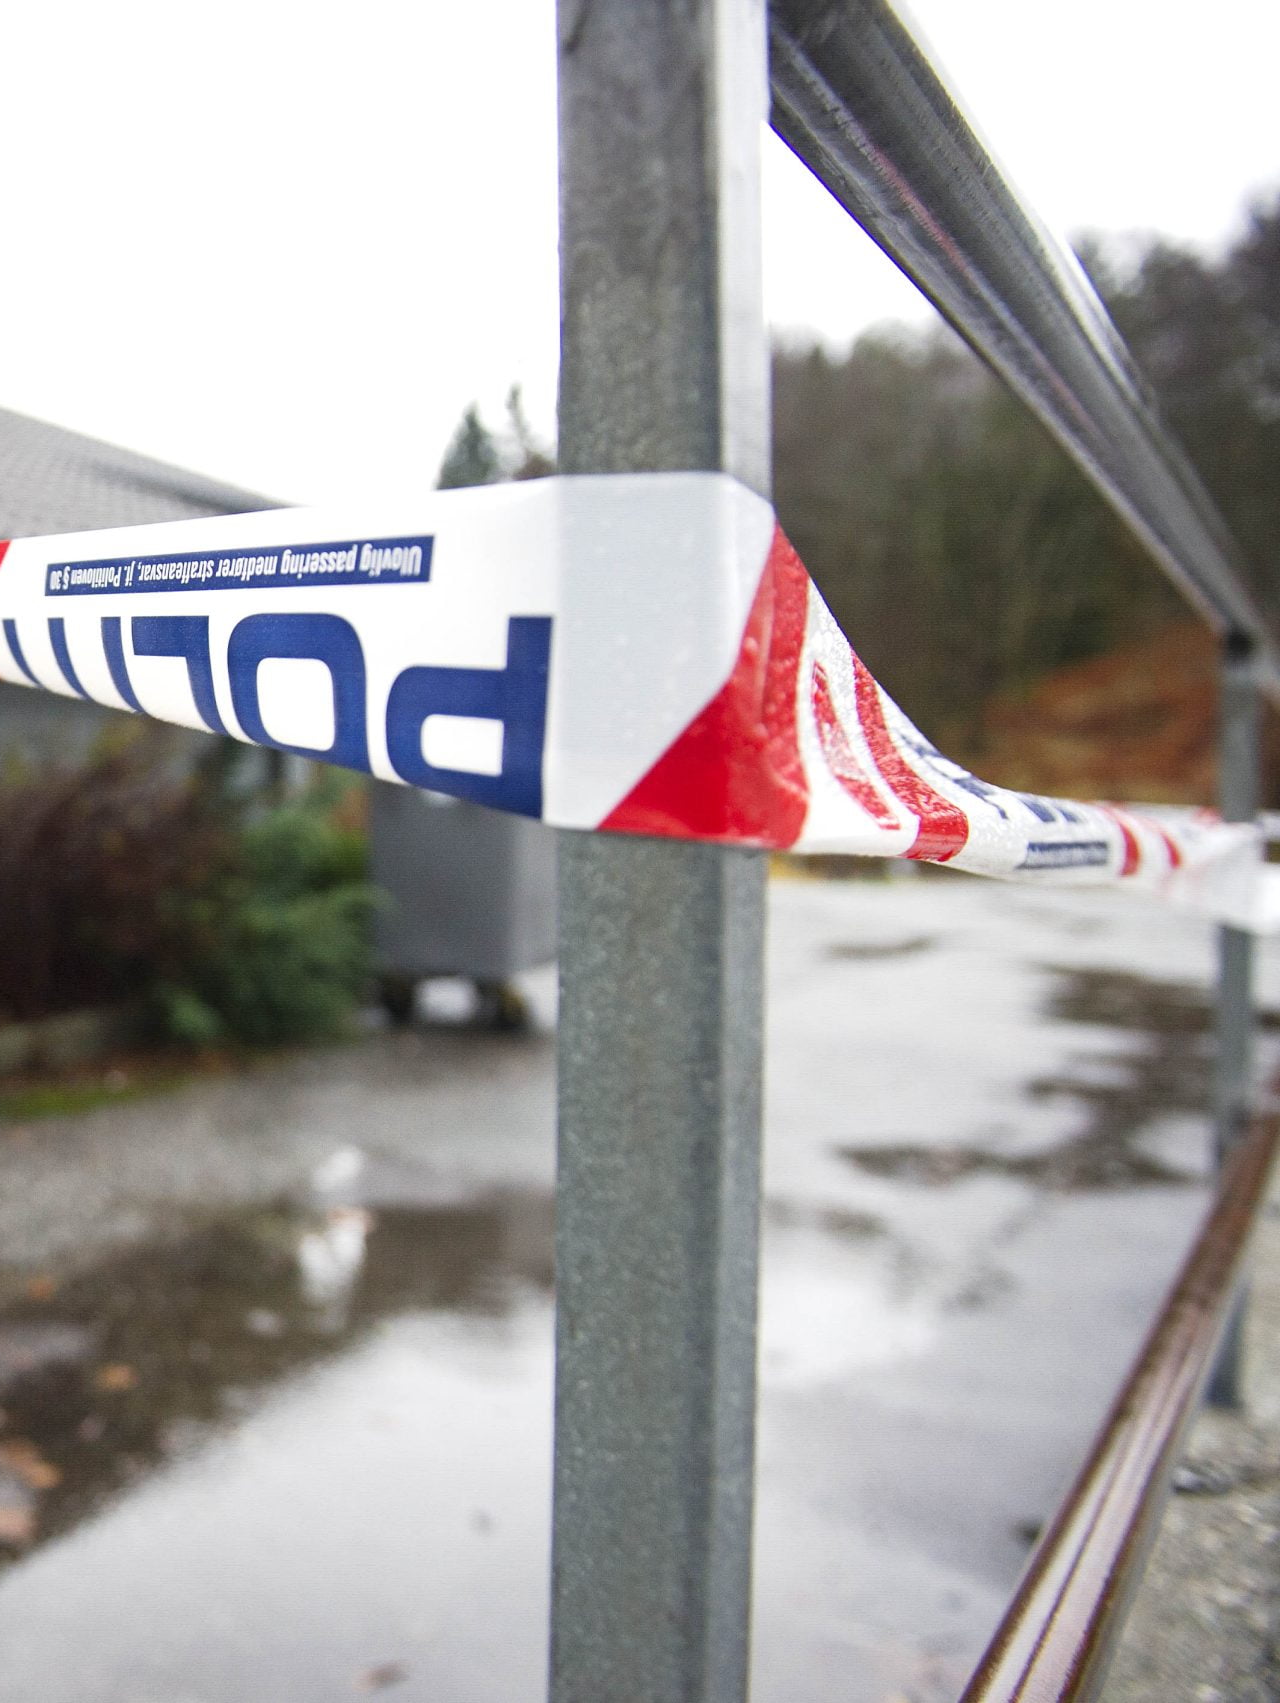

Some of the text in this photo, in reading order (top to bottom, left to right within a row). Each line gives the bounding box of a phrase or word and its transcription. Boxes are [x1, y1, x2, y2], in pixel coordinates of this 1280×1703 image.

[138, 560, 214, 584] straffeansvar,
[215, 555, 279, 582] medfører
[280, 544, 359, 580] passering
[359, 543, 423, 577] Ulovlig
[50, 570, 62, 590] 30
[71, 566, 121, 588] Politiloven
[124, 561, 136, 587] jf.
